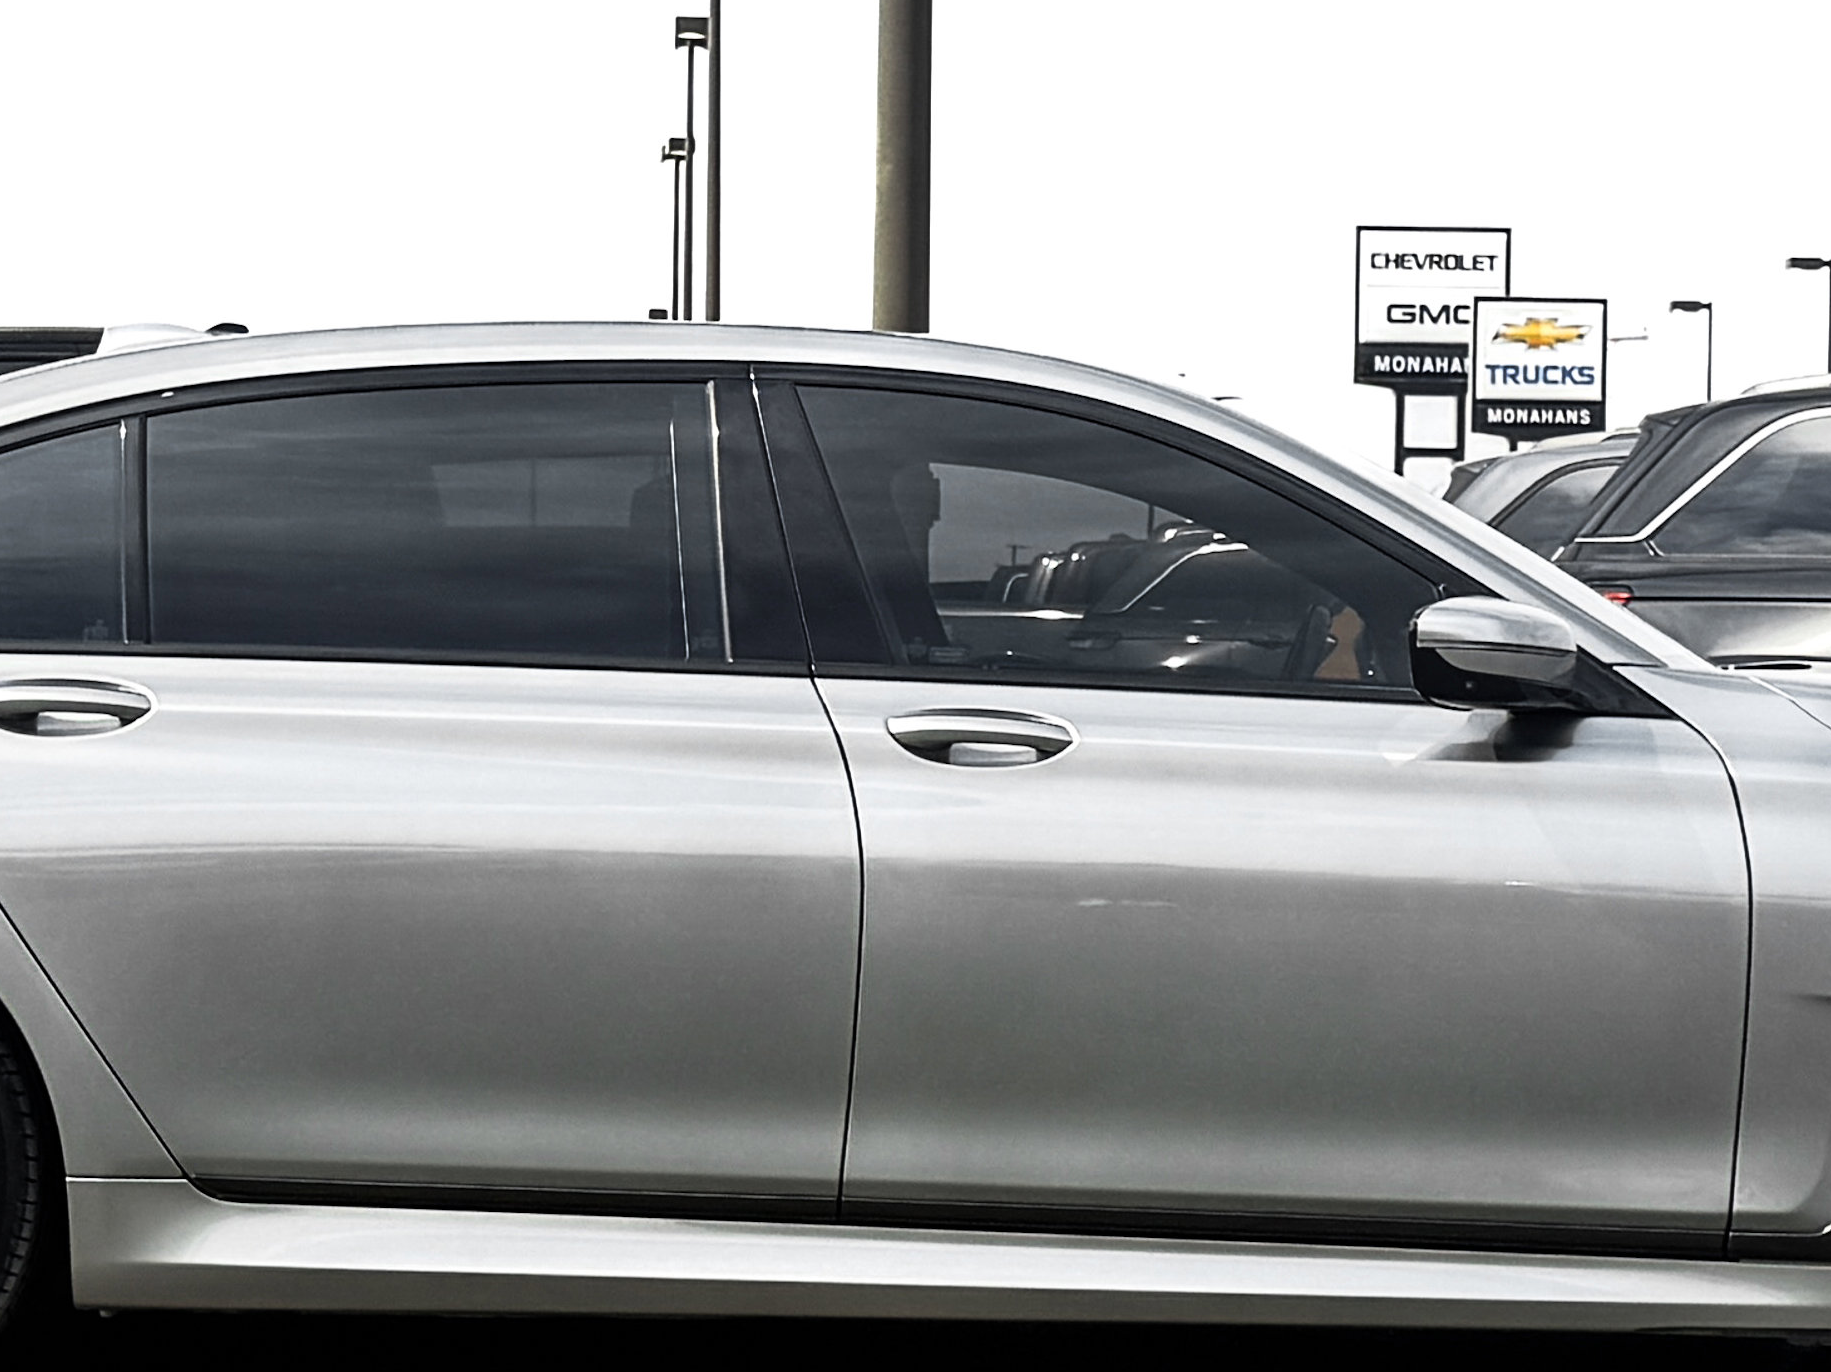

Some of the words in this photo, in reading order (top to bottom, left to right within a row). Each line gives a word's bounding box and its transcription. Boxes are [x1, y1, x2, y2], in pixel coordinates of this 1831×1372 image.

[1370, 252, 1498, 272] CHEVROLET
[1386, 303, 1471, 325] GMC
[1374, 354, 1469, 374] MONAHA
[1485, 364, 1595, 385] TRUCKS
[1486, 407, 1592, 425] MONAHANS
